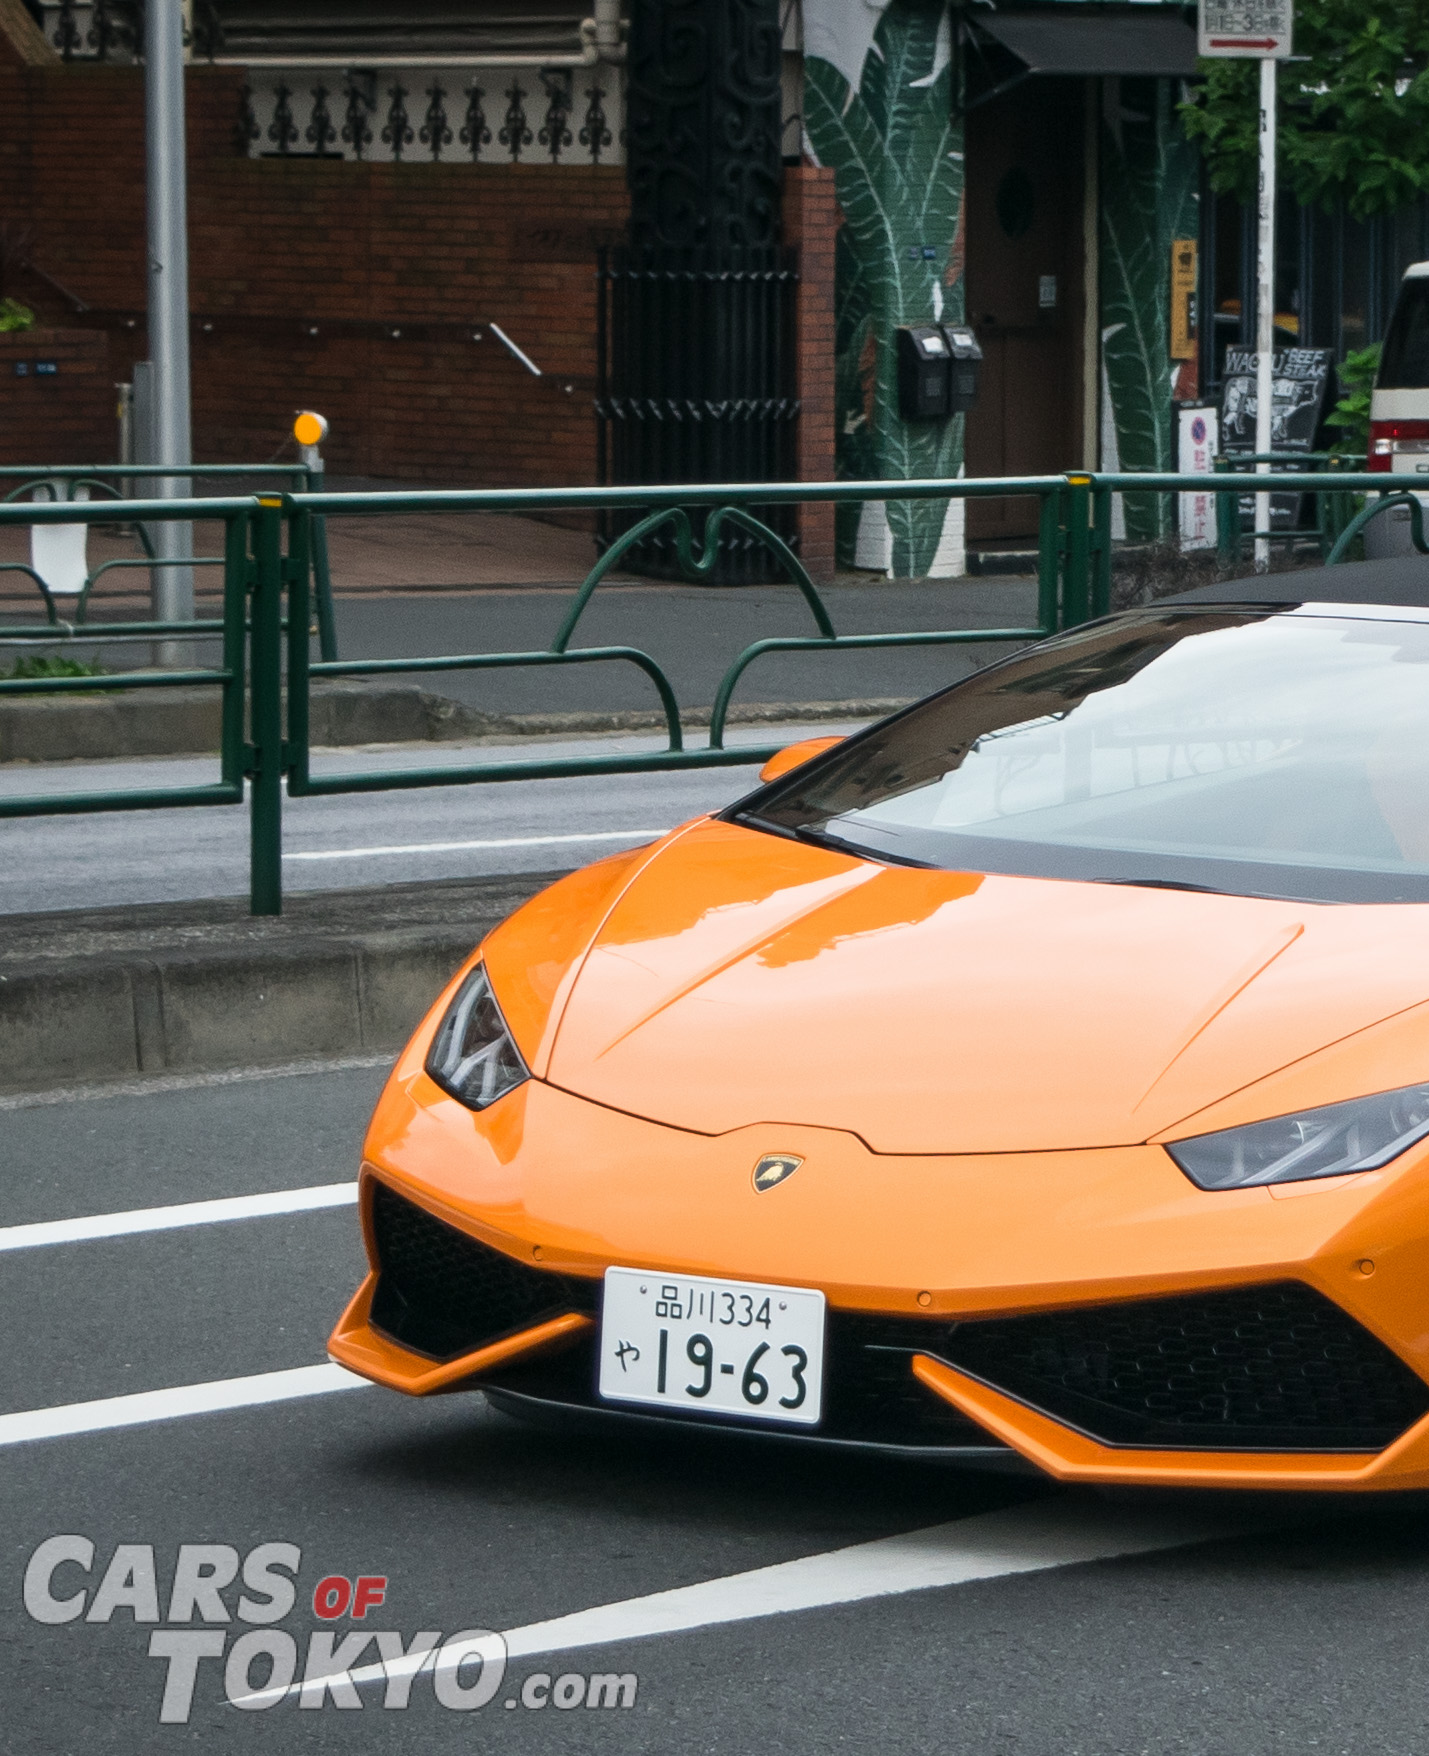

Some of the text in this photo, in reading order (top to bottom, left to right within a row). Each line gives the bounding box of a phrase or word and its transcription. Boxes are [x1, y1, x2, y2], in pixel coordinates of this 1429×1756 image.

[1226, 352, 1284, 372] WAGU
[655, 1285, 772, 1330] 品川334
[614, 1328, 808, 1410] や 19-63
